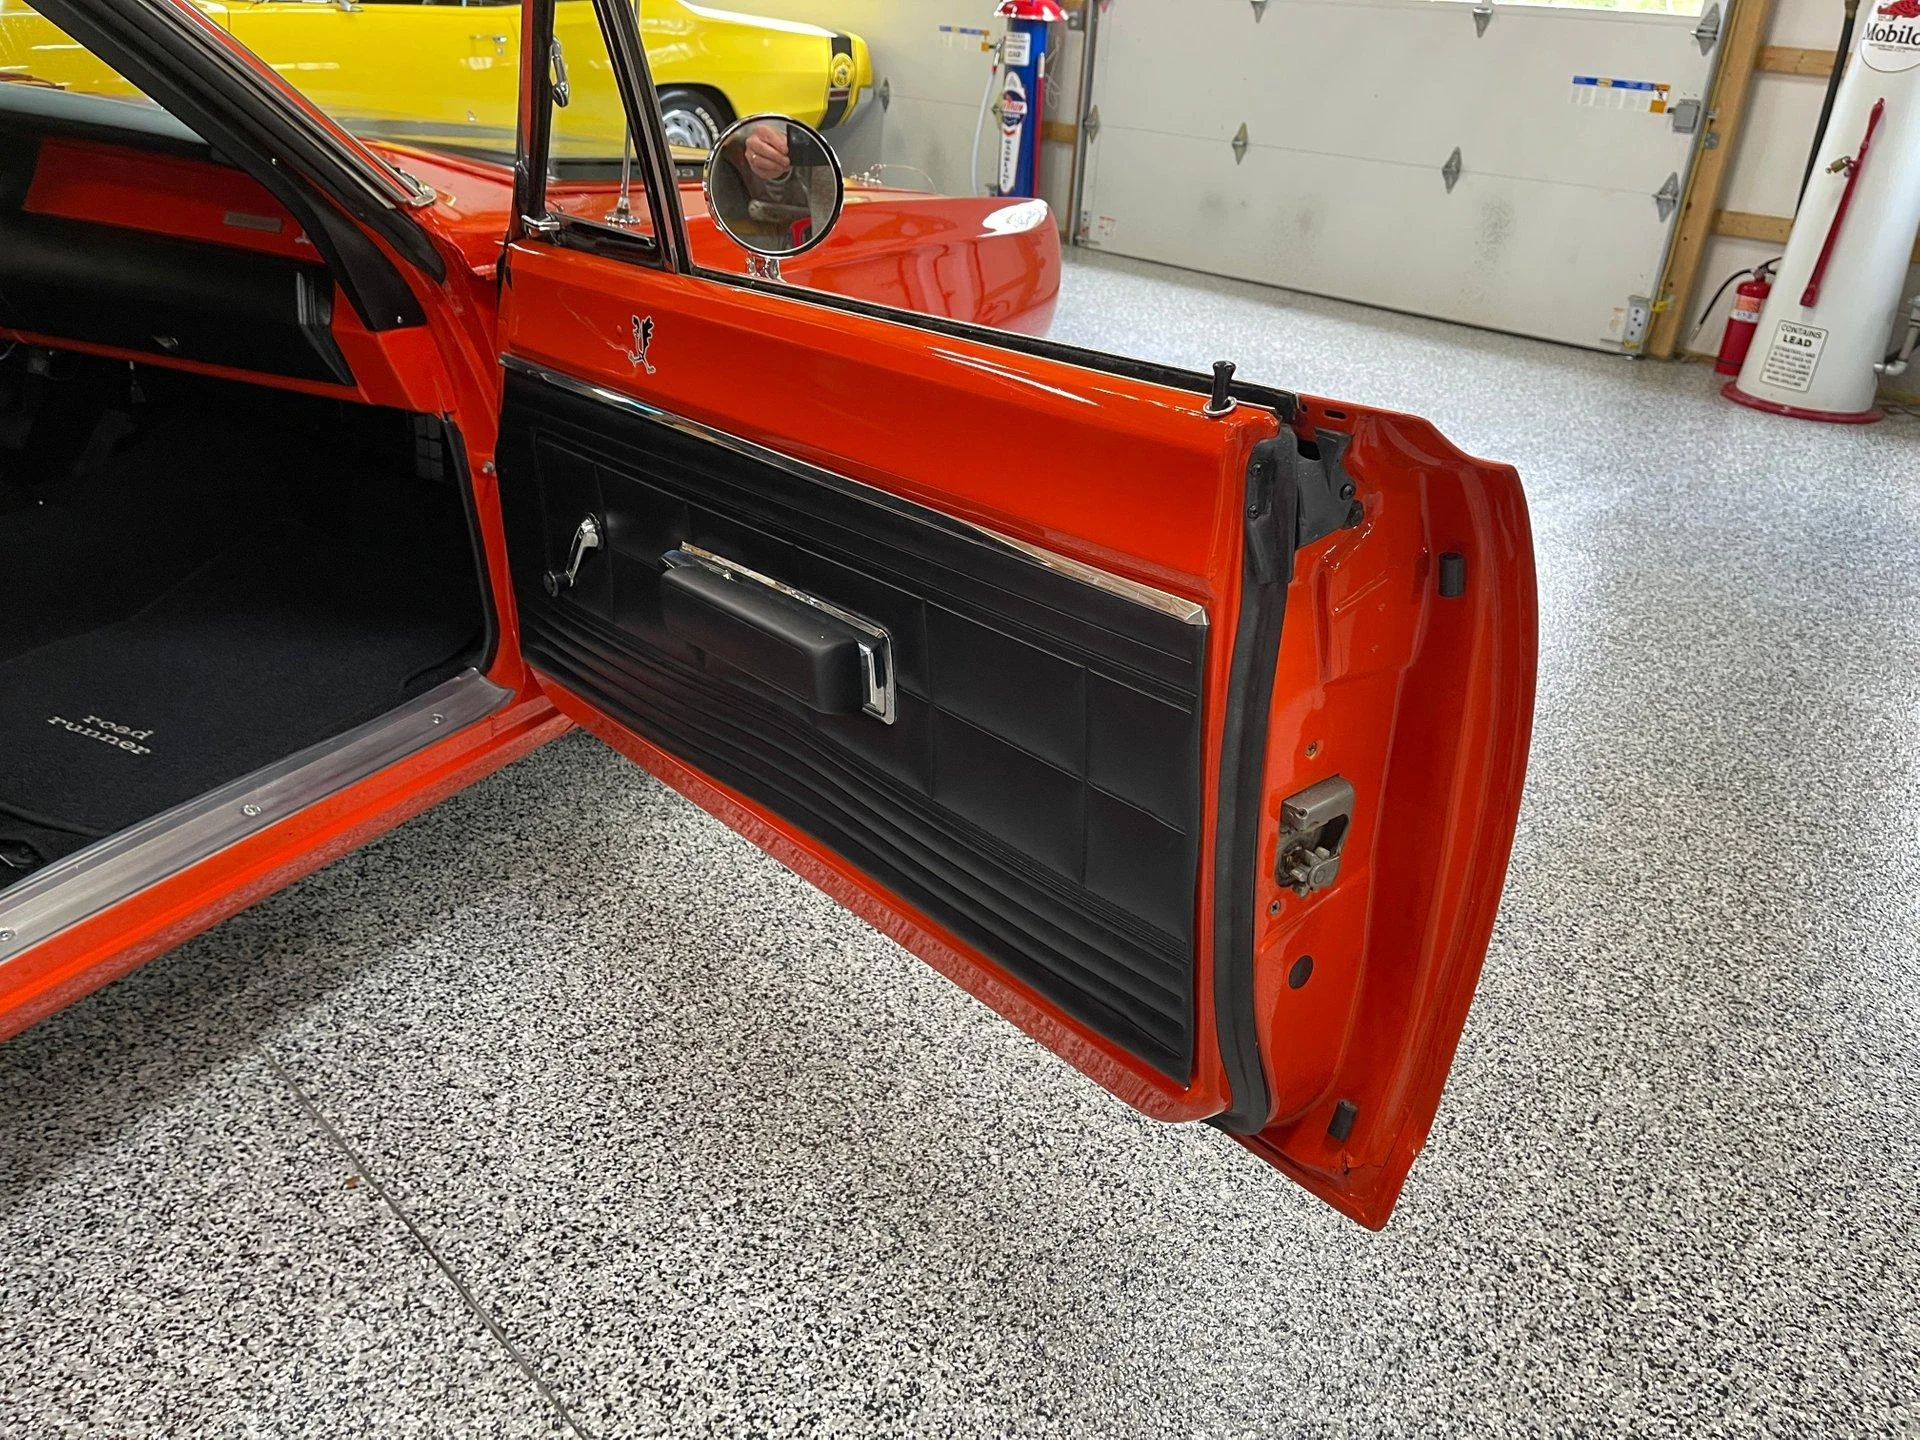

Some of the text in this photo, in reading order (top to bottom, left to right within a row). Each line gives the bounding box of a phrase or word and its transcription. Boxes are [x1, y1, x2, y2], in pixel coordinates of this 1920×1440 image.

[1780, 323, 1822, 339] CONTAINS
[1782, 334, 1812, 347] LEAD
[47, 716, 151, 755] runner
[82, 715, 154, 740] road
